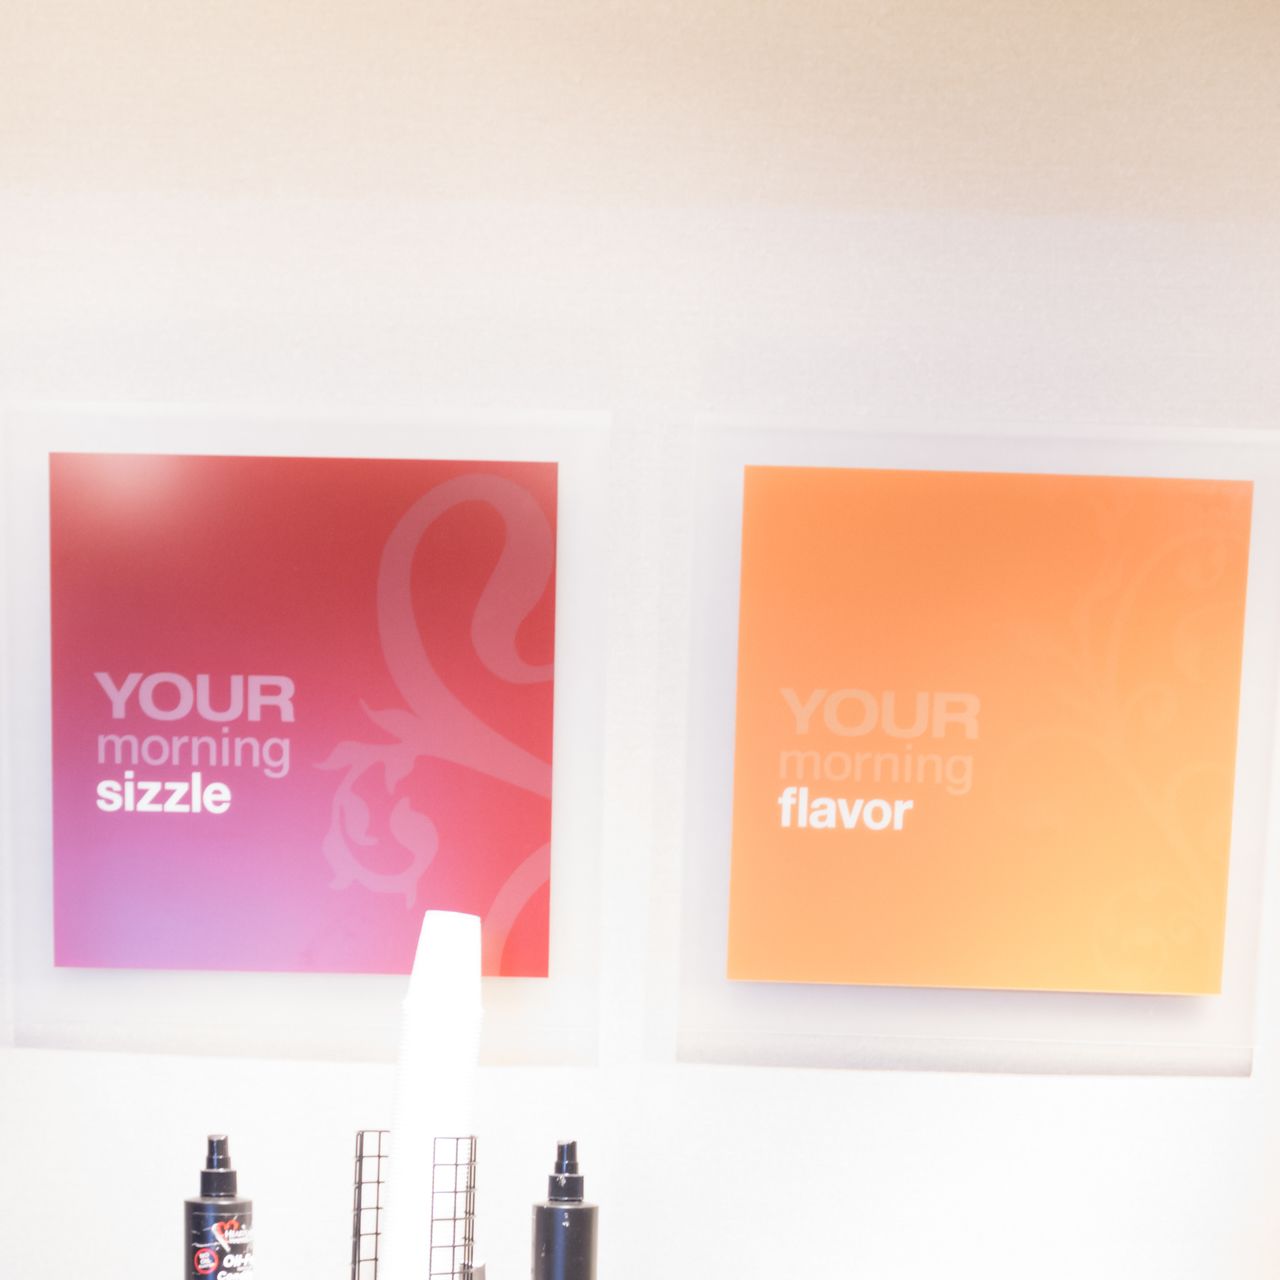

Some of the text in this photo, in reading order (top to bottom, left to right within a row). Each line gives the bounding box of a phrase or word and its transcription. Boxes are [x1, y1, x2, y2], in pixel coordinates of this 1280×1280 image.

[93, 672, 296, 722] YOUR
[779, 688, 981, 739] YOUR
[97, 727, 290, 778] morning
[778, 745, 973, 795] morning
[96, 770, 231, 814] sizzle
[778, 786, 914, 830] flavor
